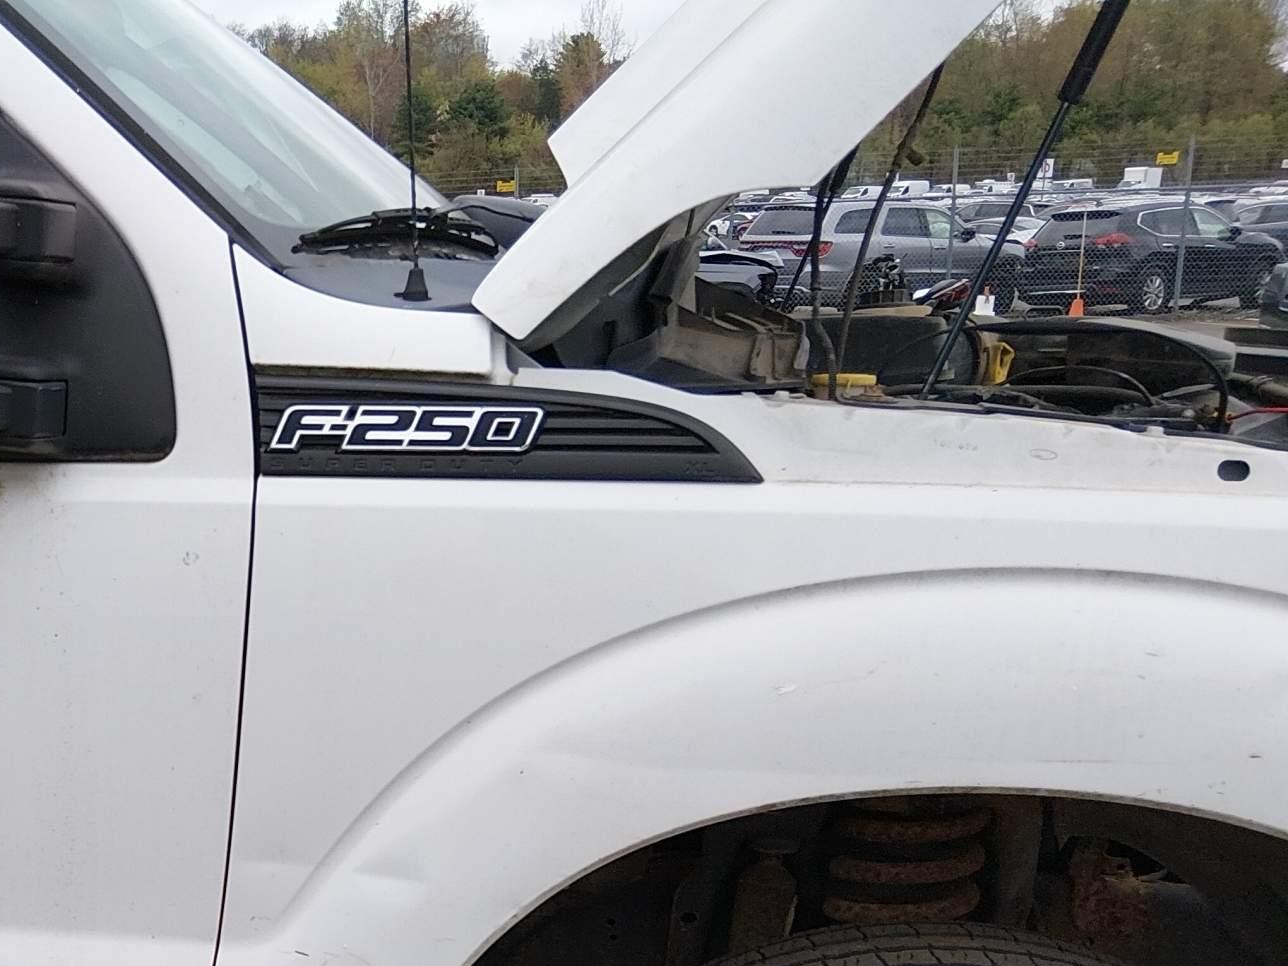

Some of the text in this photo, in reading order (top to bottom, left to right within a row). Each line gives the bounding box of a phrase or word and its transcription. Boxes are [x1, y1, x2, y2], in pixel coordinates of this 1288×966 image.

[270, 405, 544, 451] F-250
[269, 456, 524, 473] SUPER DUTY
